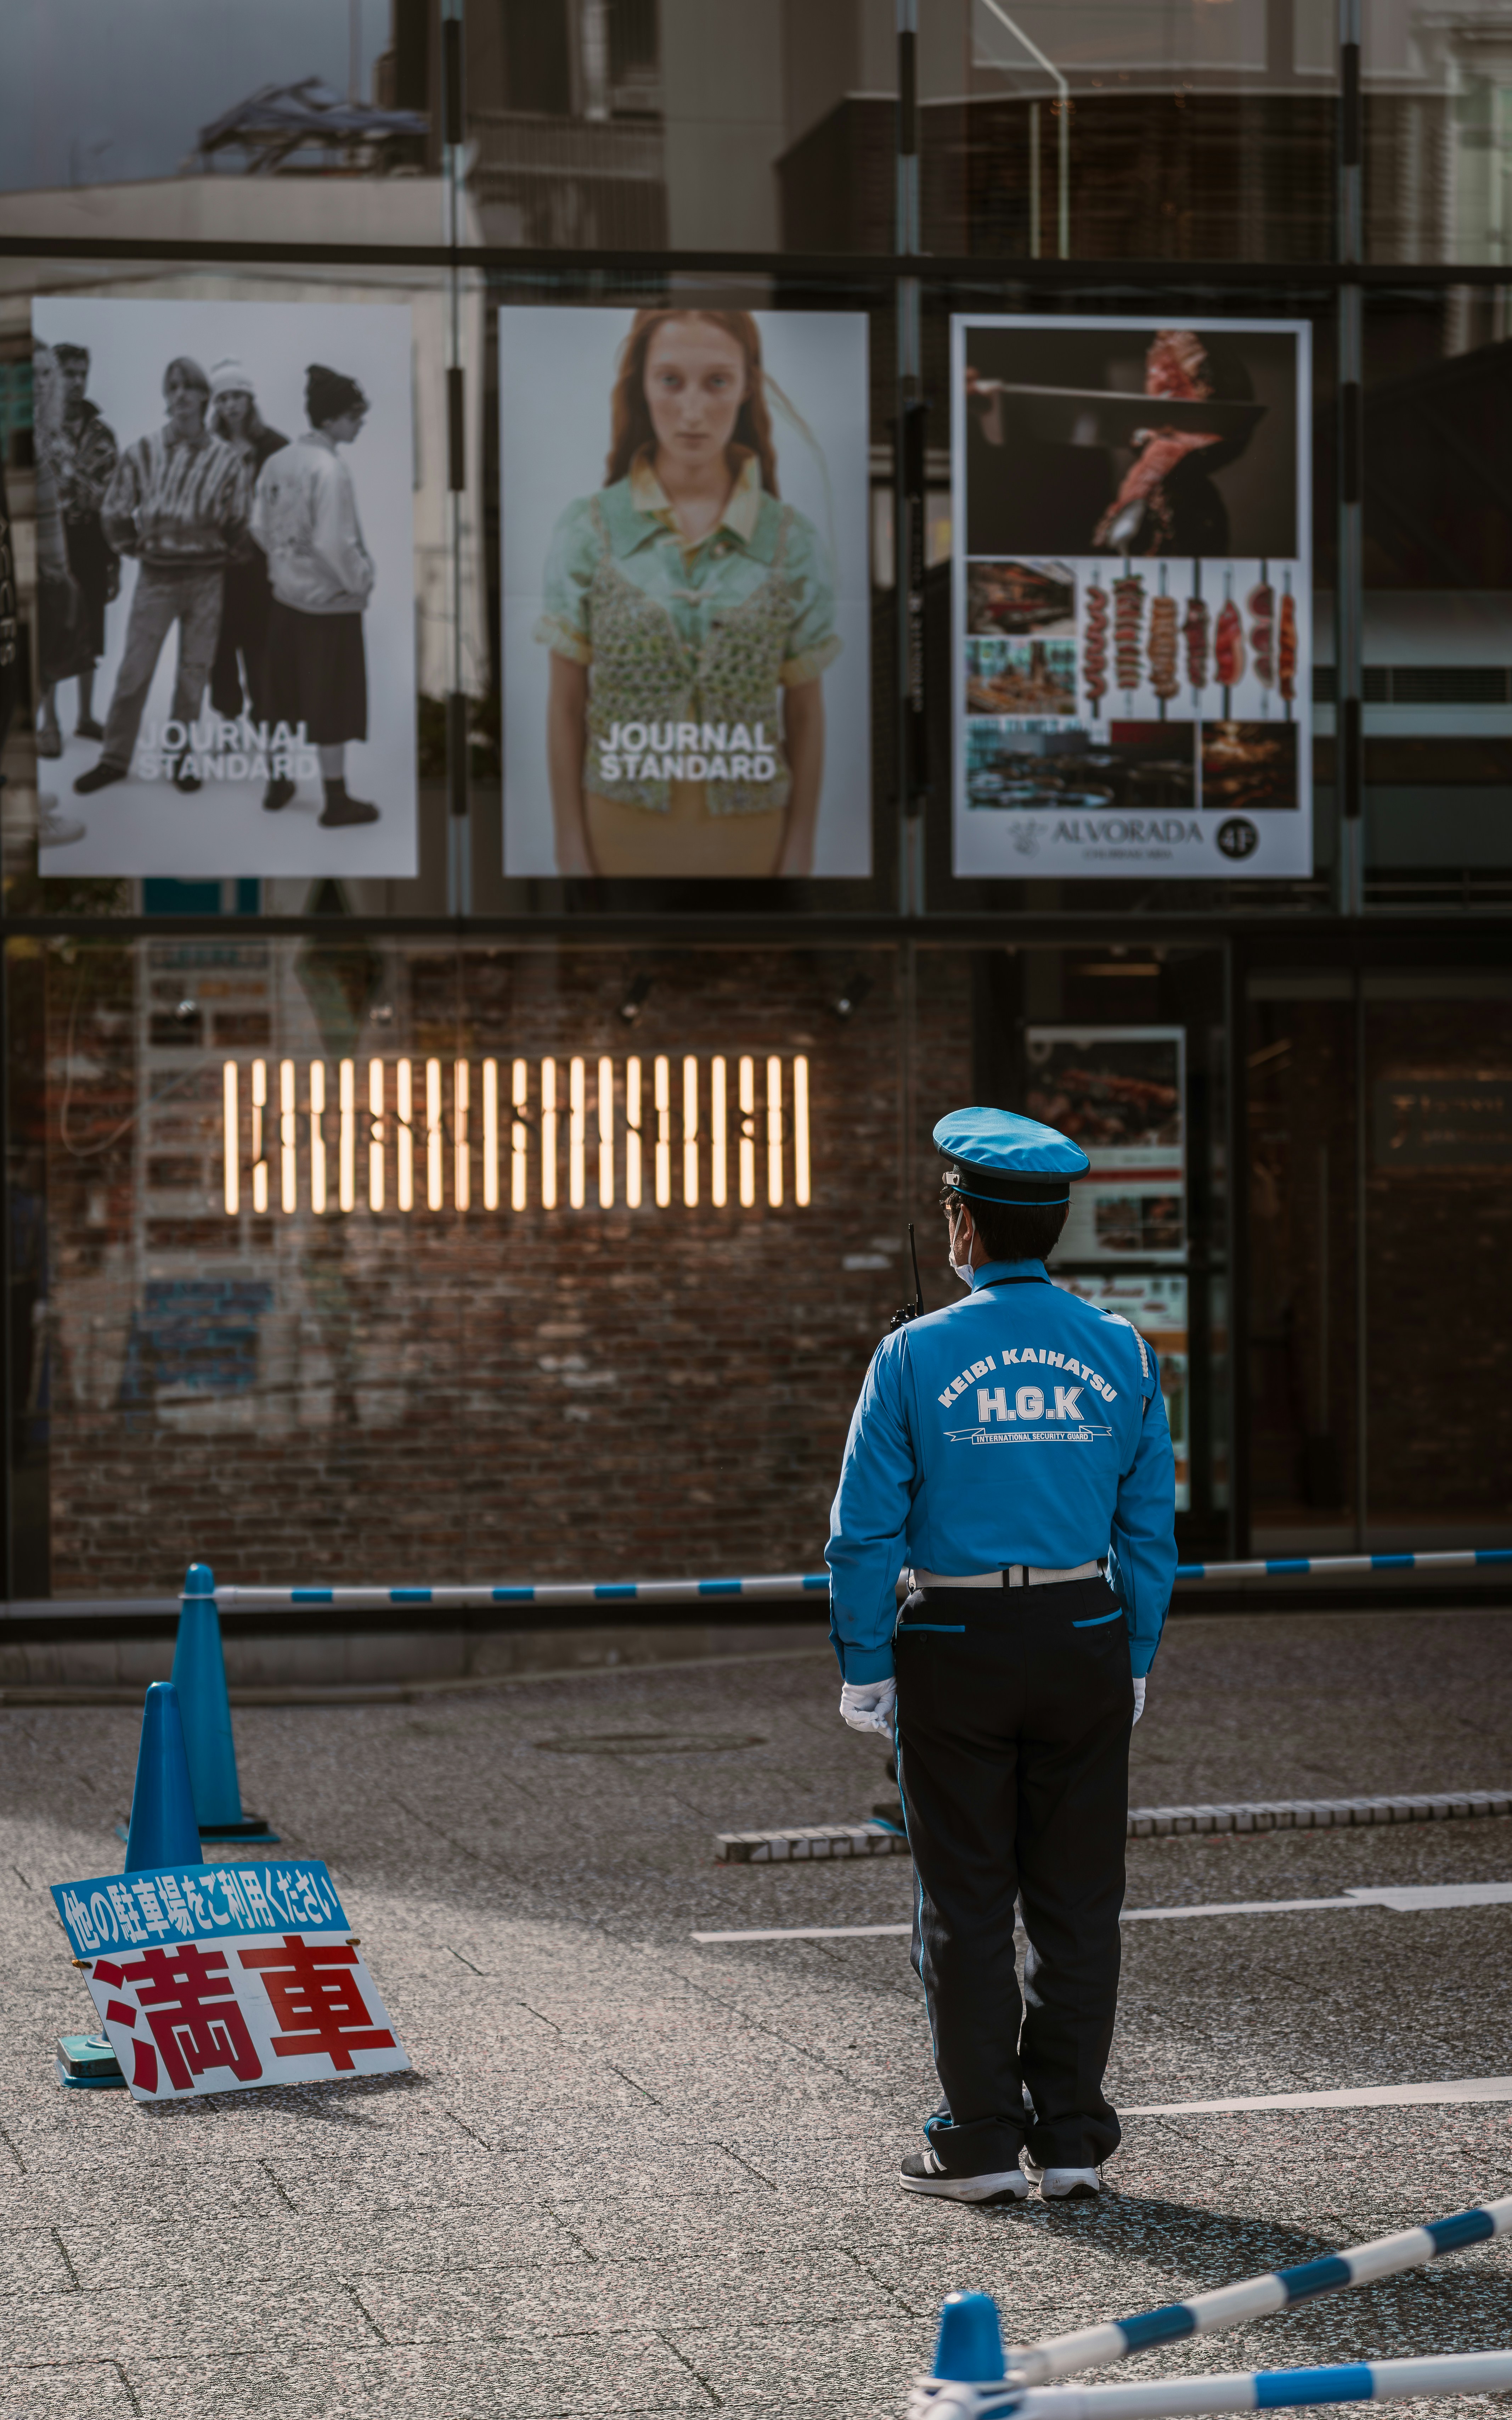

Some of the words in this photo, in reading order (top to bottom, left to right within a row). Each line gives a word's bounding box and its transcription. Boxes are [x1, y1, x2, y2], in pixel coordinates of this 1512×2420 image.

[140, 720, 318, 752] JOURNAL
[599, 721, 775, 752] JOURNAL
[137, 752, 320, 780] STANDARD
[599, 753, 777, 781] STANDARD
[1050, 819, 1204, 844] ALVORADA
[1220, 826, 1253, 851] 4F
[938, 1355, 997, 1408] KEIBI
[1002, 1348, 1118, 1402] KAIHATSU
[977, 1386, 1085, 1422] H.G.K
[977, 1433, 1031, 1443] INTERNATIONAL
[61, 1867, 338, 1953] 他の駐車場をご利用ください
[92, 1935, 397, 2094] 満車
